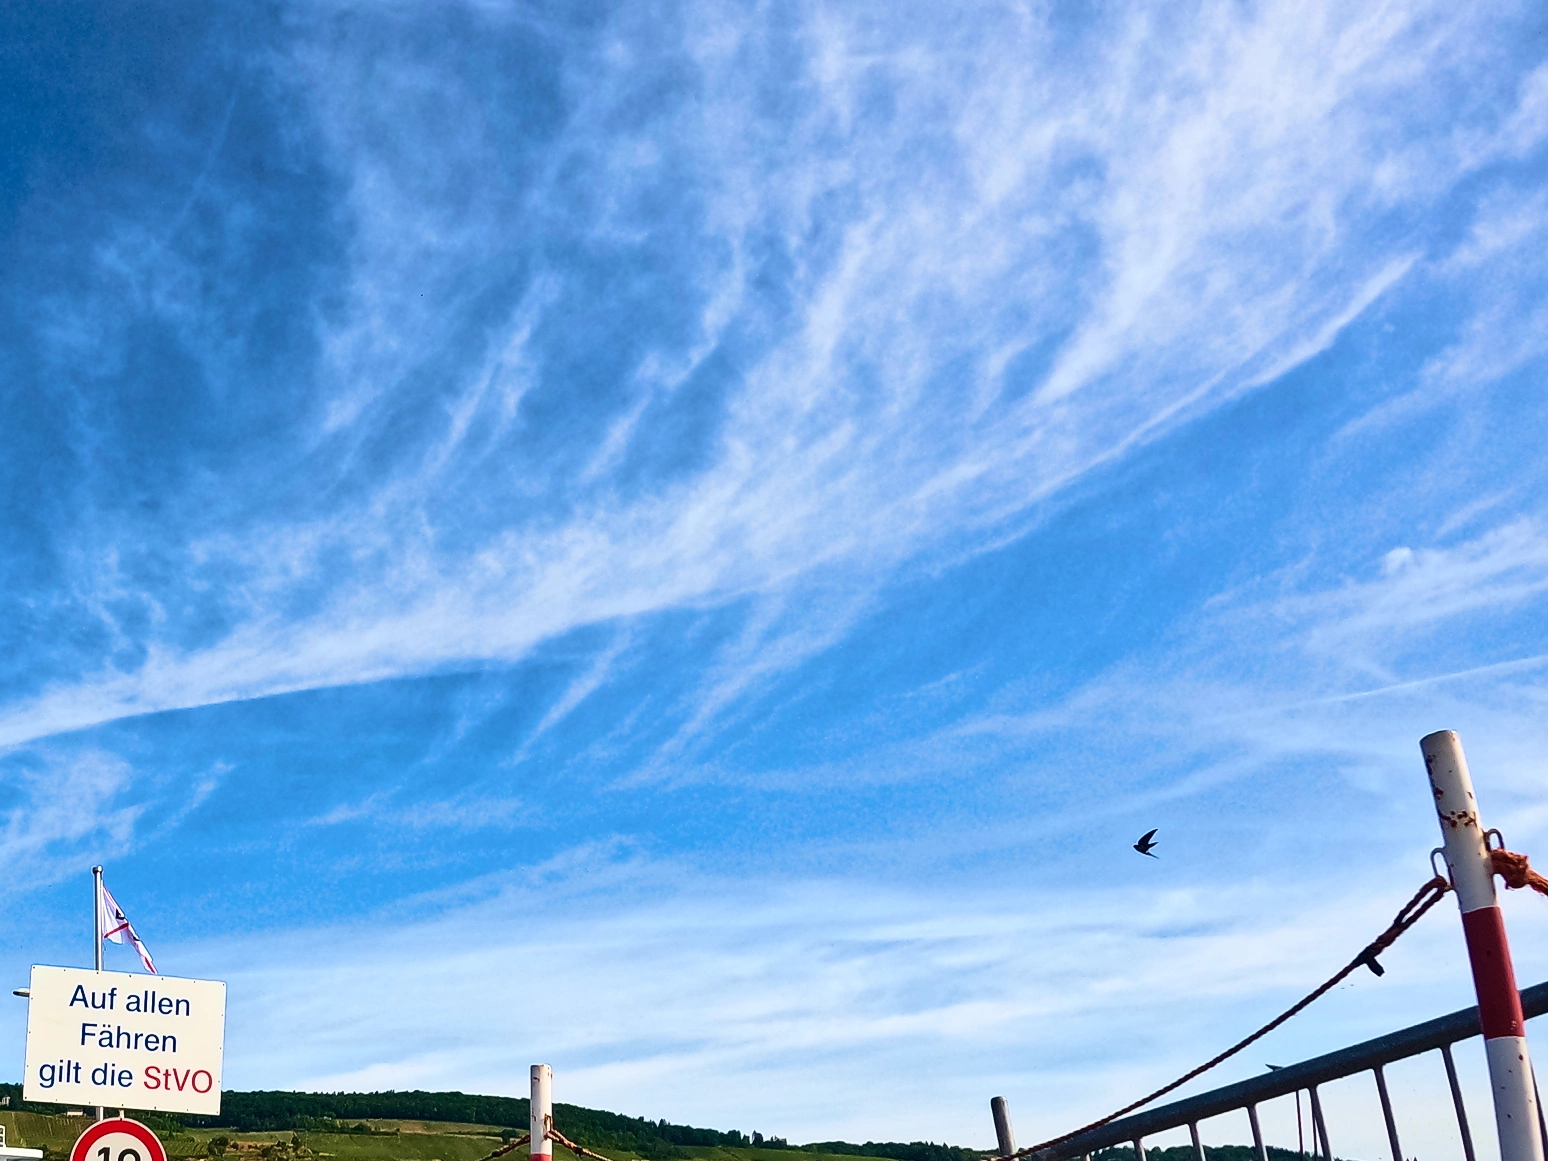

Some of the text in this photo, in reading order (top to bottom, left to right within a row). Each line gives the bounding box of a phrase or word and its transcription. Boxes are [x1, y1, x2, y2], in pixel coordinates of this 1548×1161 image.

[69, 984, 190, 1016] Auf allen
[81, 1022, 177, 1052] Fähren
[39, 1059, 213, 1093] gilt die StVO
